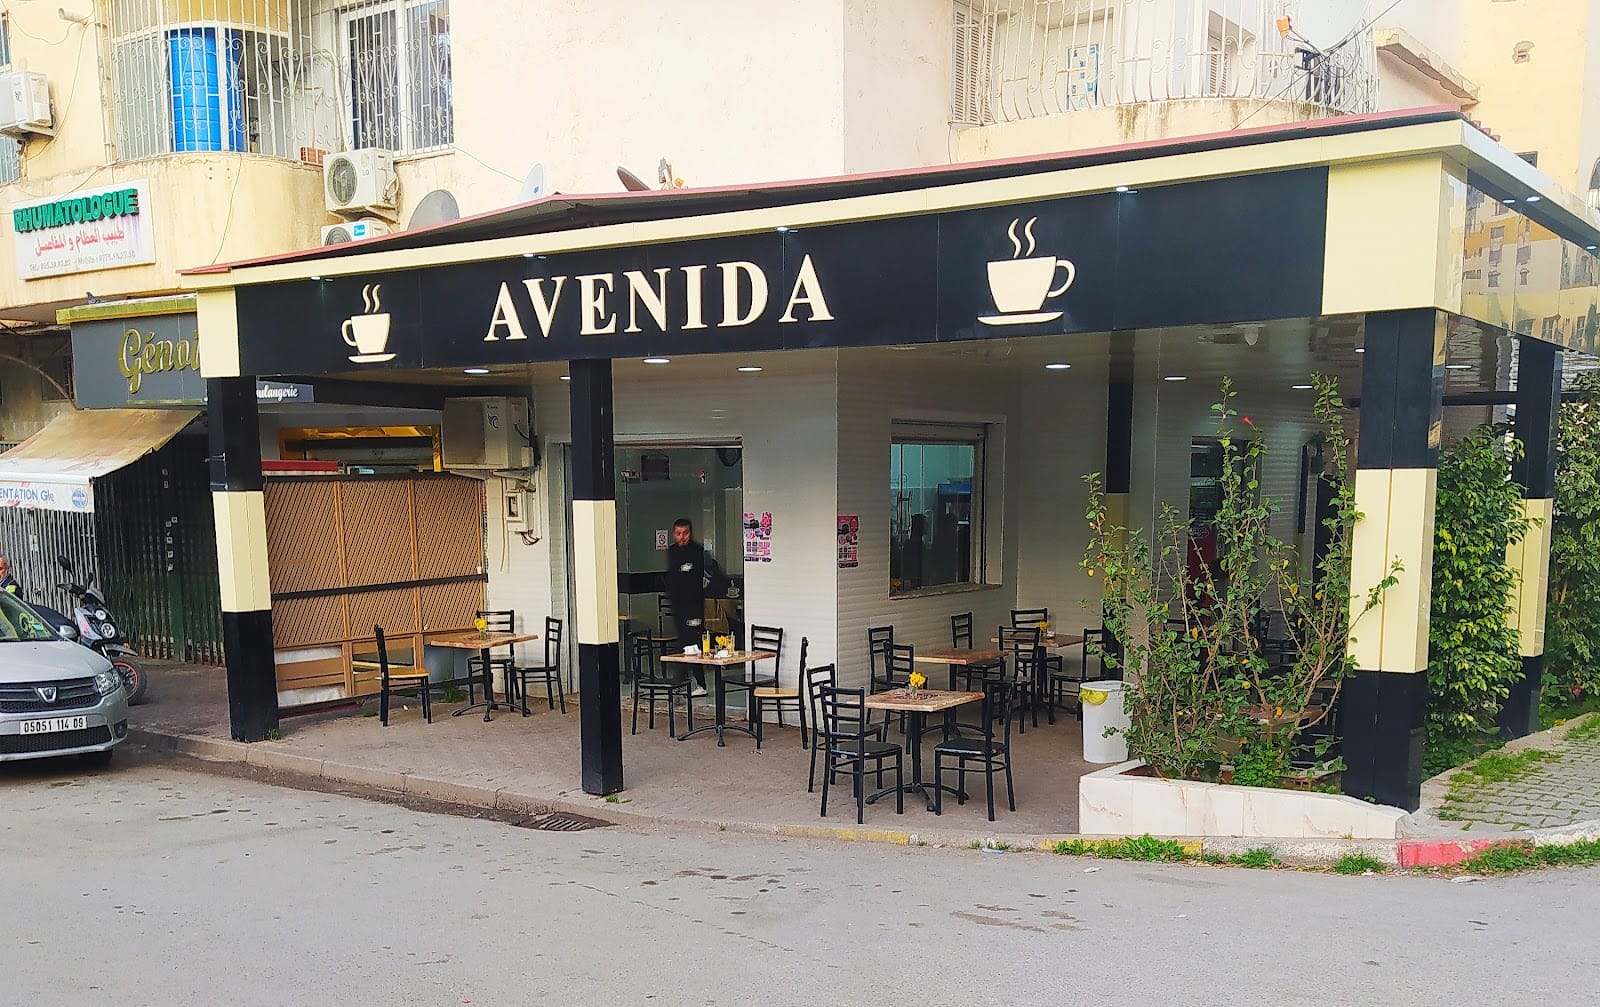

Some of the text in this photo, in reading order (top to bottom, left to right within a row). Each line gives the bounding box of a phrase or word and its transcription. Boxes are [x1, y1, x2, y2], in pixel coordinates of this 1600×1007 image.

[13, 188, 139, 233] RHUMATOLOGUE
[102, 225, 125, 245] طبيب
[483, 253, 835, 342] AVENIDA
[24, 717, 83, 733] 05051 114 09
